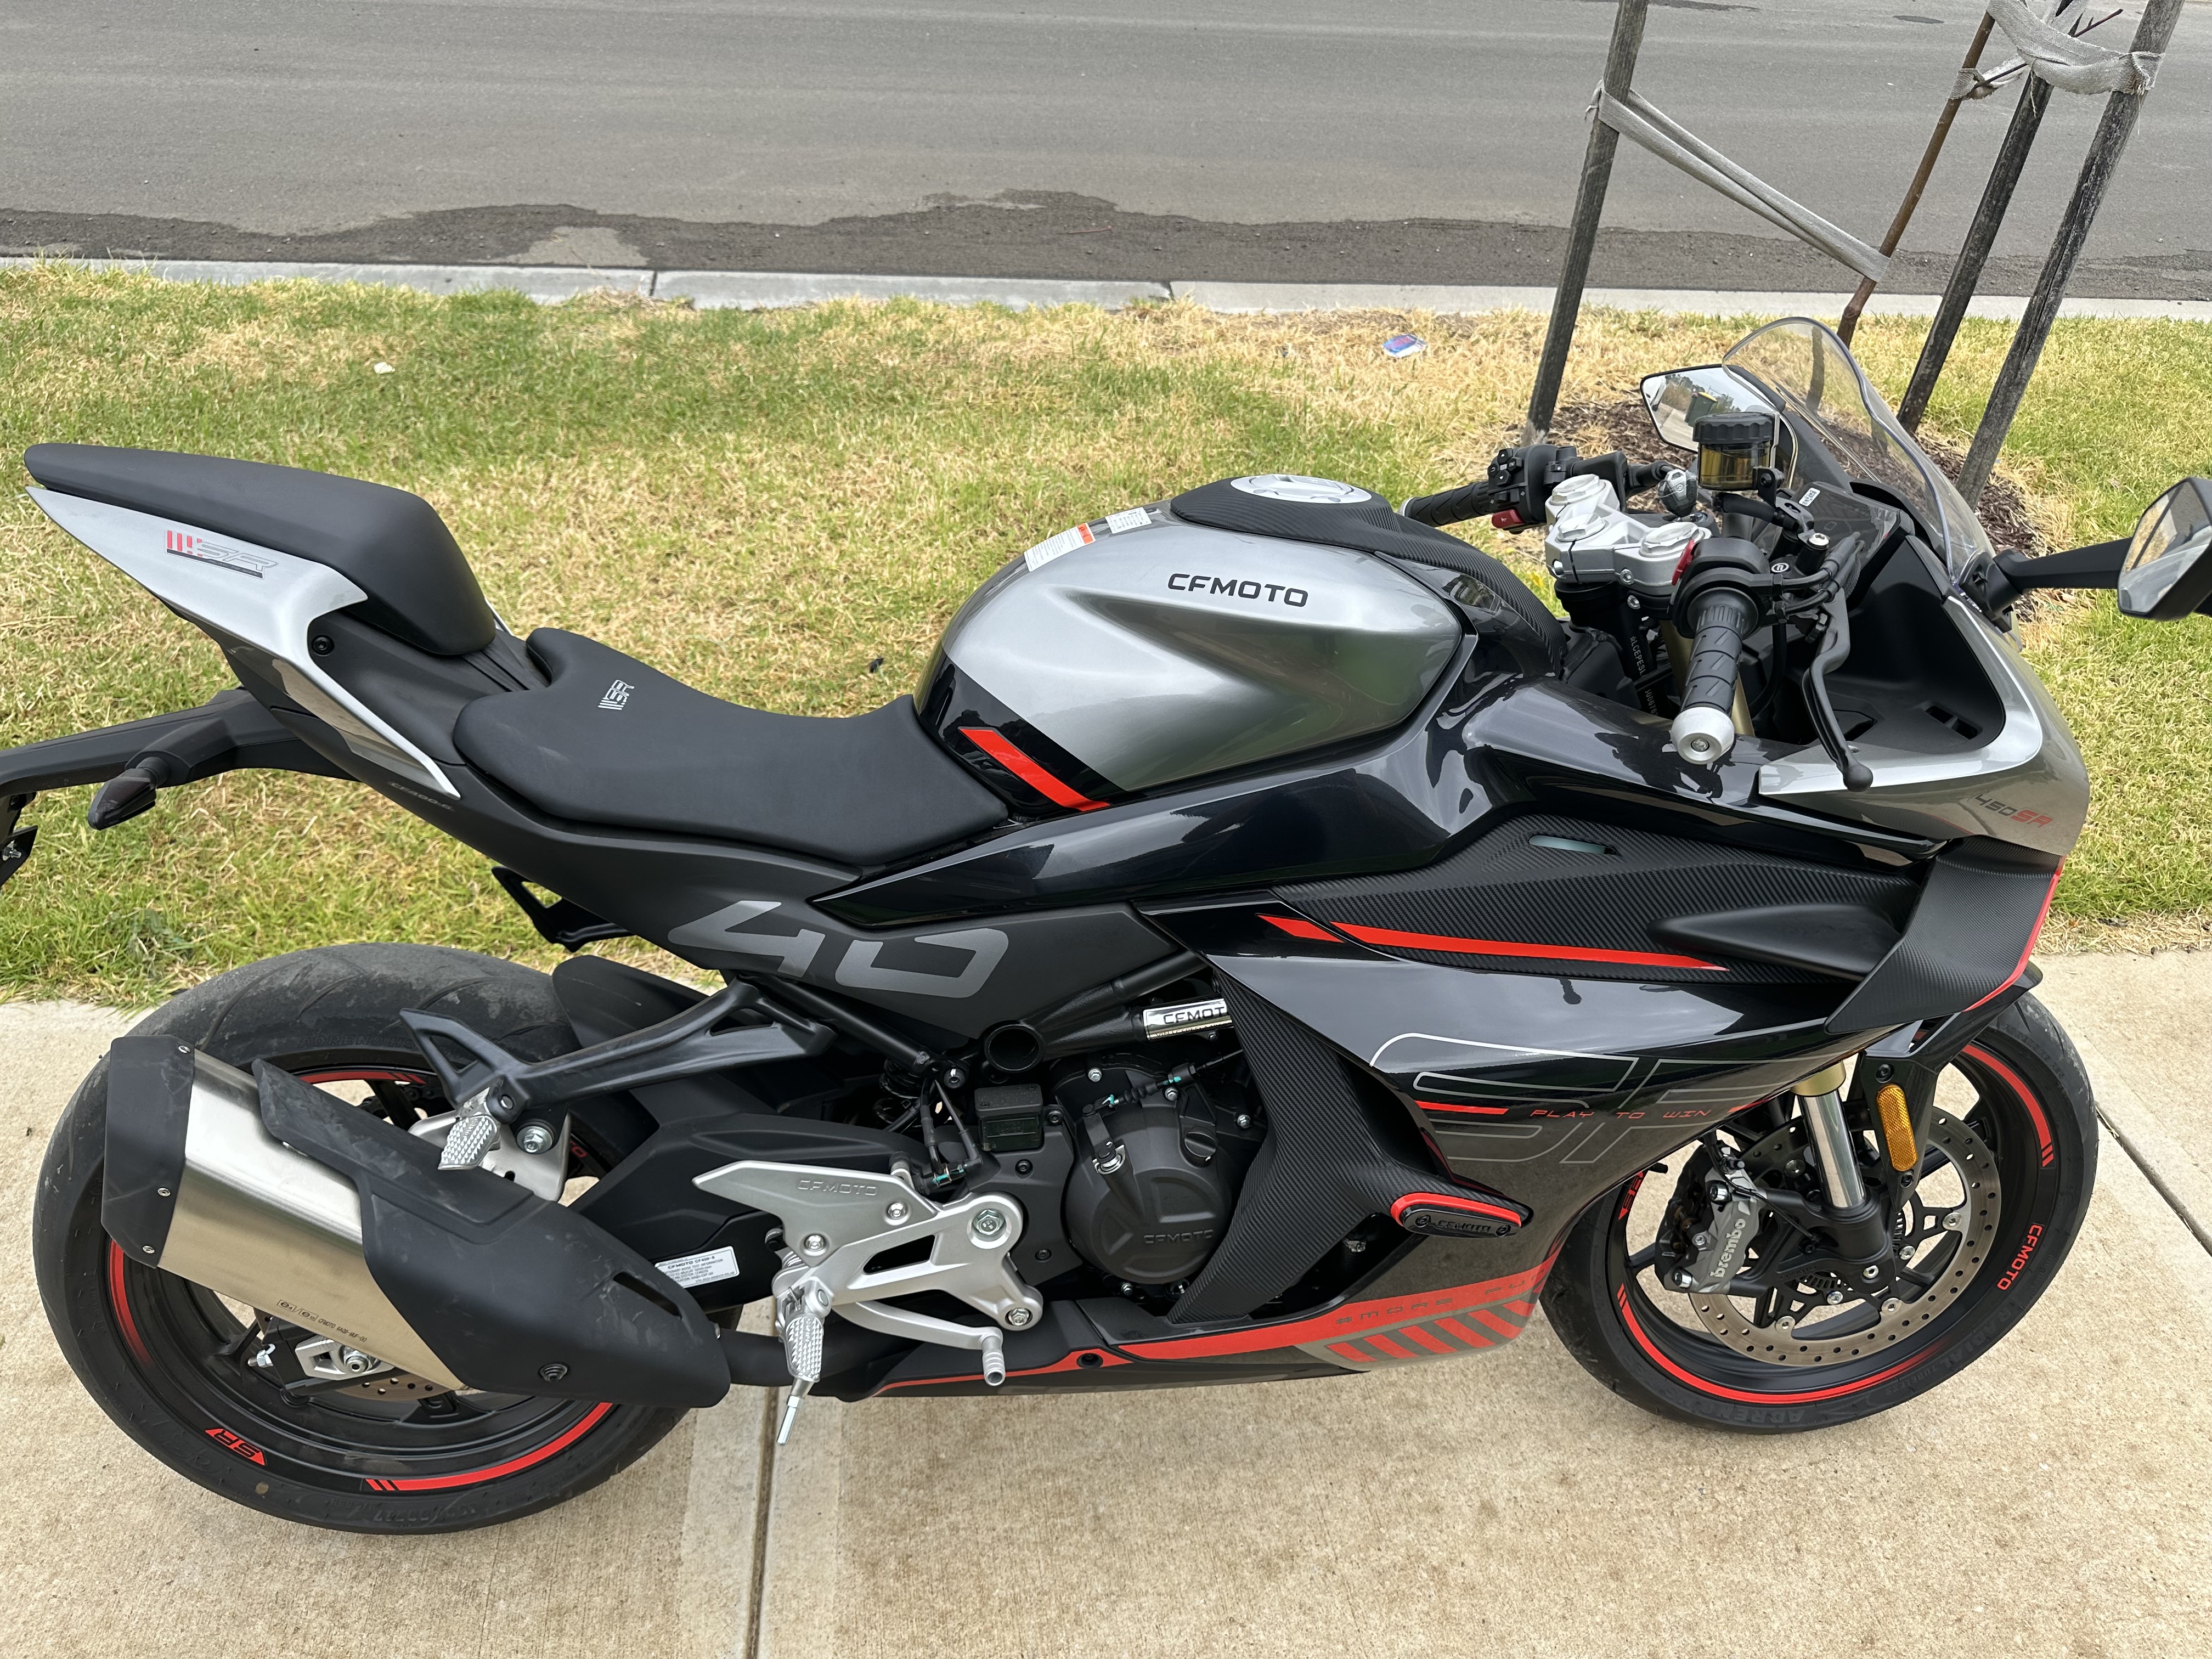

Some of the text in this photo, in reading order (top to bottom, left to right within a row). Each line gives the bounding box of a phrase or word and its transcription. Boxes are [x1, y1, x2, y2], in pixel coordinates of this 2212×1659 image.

[1167, 573, 1308, 607] CFMOTO
[1975, 794, 2053, 828] 450SR
[1530, 1109, 1595, 1118] PLAY
[1662, 1109, 1712, 1119] WIN
[798, 1180, 878, 1196] CFMOTO
[1143, 1229, 1214, 1244] CFMOTO
[1709, 1218, 1746, 1278] brembo
[668, 1261, 693, 1269] CFMOTO
[1997, 1224, 2043, 1290] CFMOTO
[213, 1430, 261, 1458] SR
